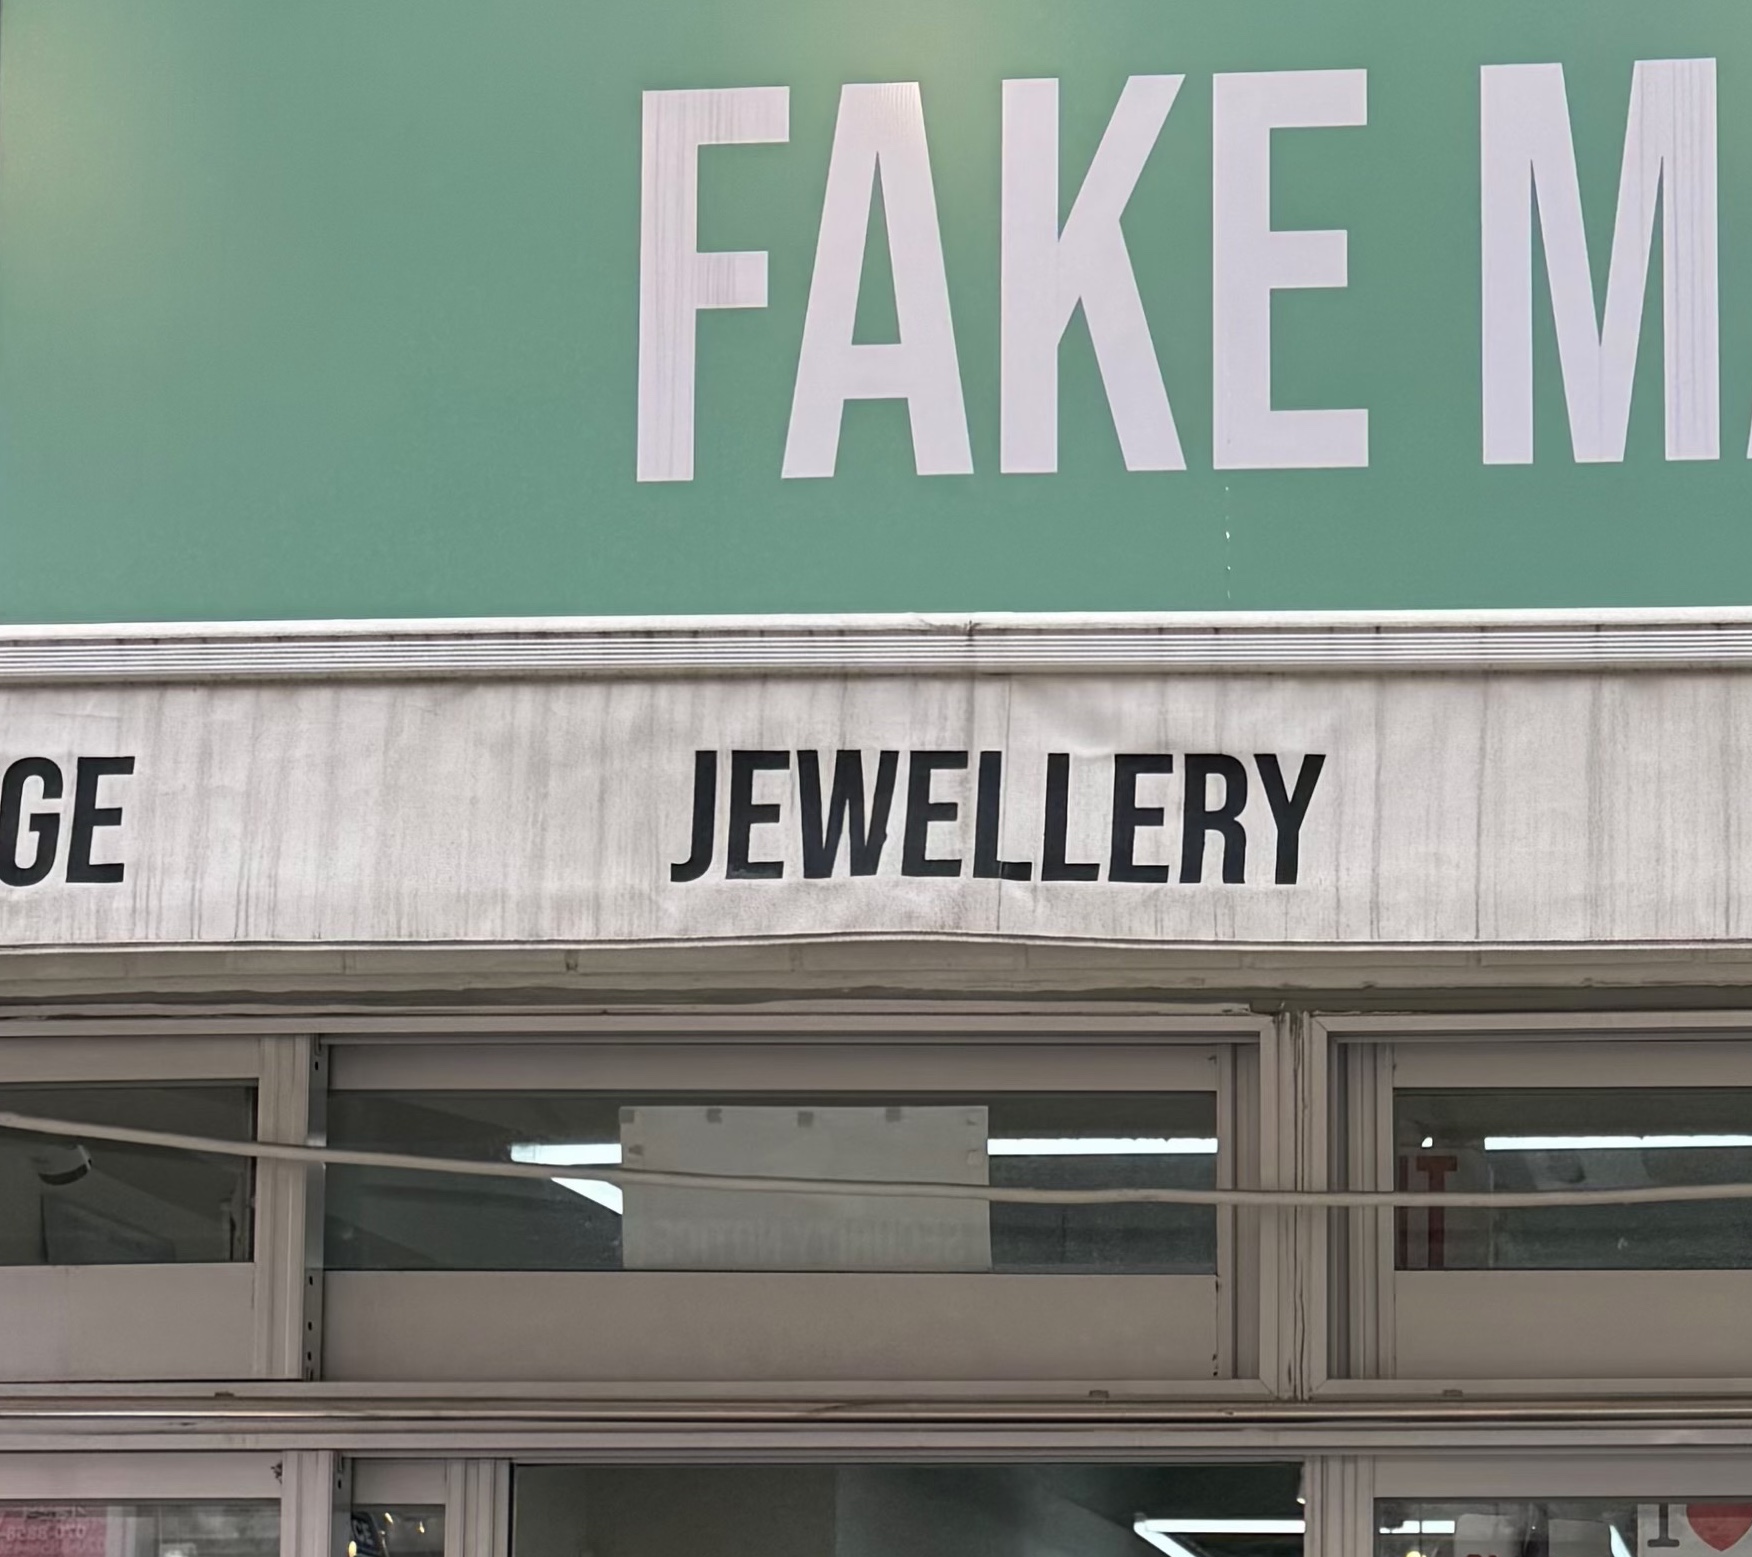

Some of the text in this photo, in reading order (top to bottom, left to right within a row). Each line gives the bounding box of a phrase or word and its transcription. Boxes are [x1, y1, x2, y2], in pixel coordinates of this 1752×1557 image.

[636, 69, 1368, 481] FAKE
[670, 749, 1327, 886] JEWELLERY
[1647, 1503, 1680, 1548] I
